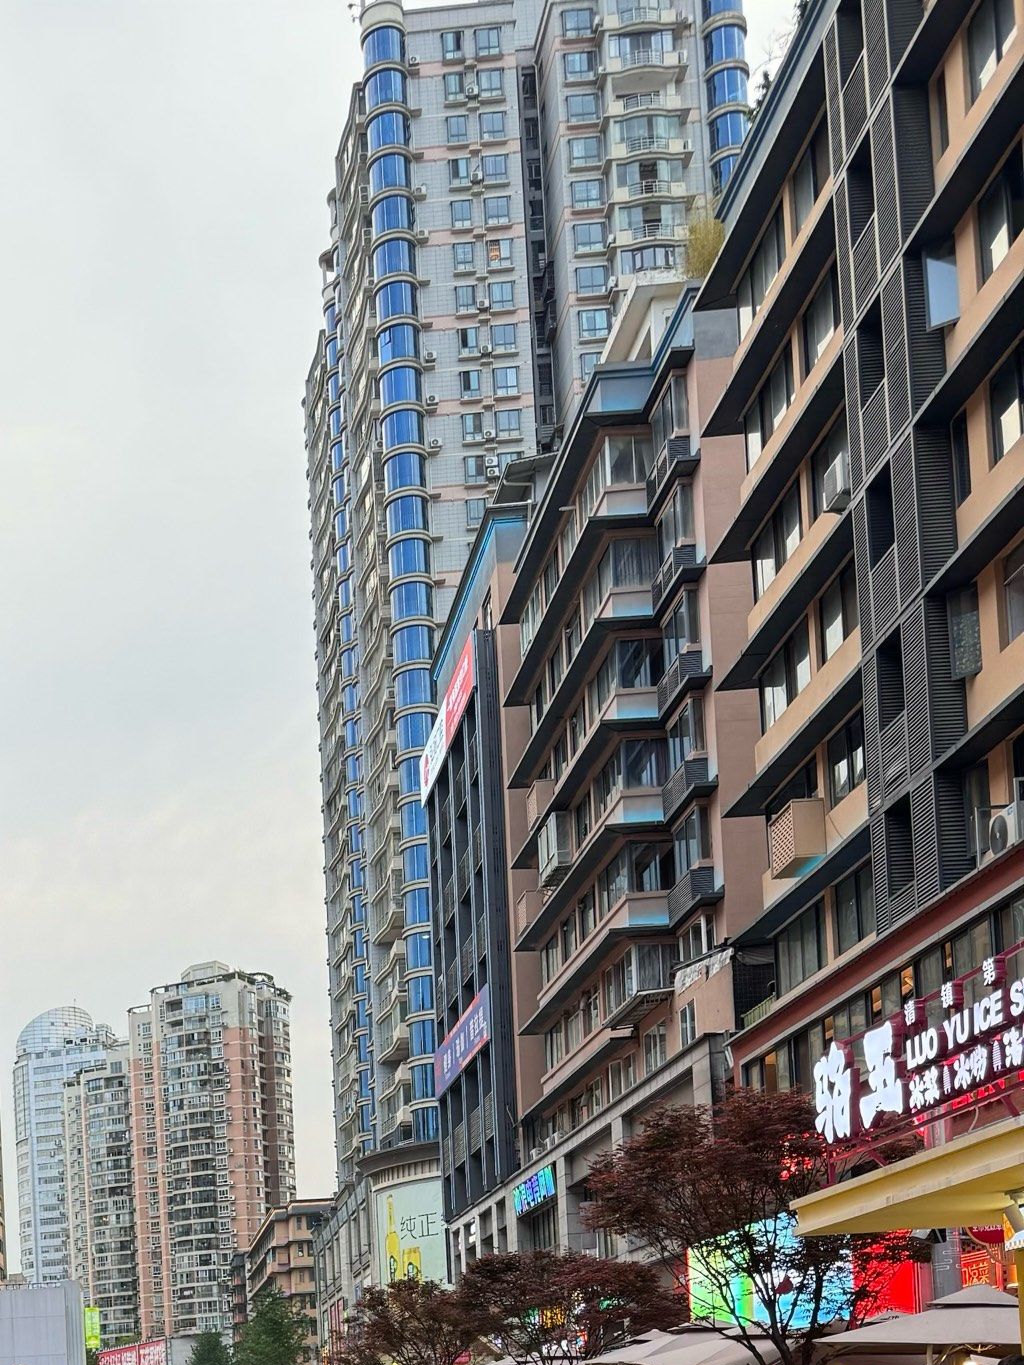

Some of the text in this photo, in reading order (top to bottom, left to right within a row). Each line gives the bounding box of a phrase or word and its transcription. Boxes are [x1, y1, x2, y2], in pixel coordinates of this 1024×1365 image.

[906, 1027, 938, 1070] LUO
[943, 1009, 969, 1049] YU
[974, 990, 1002, 1036] ICE
[1010, 977, 1024, 1016] S
[400, 1211, 443, 1241] 纯正
